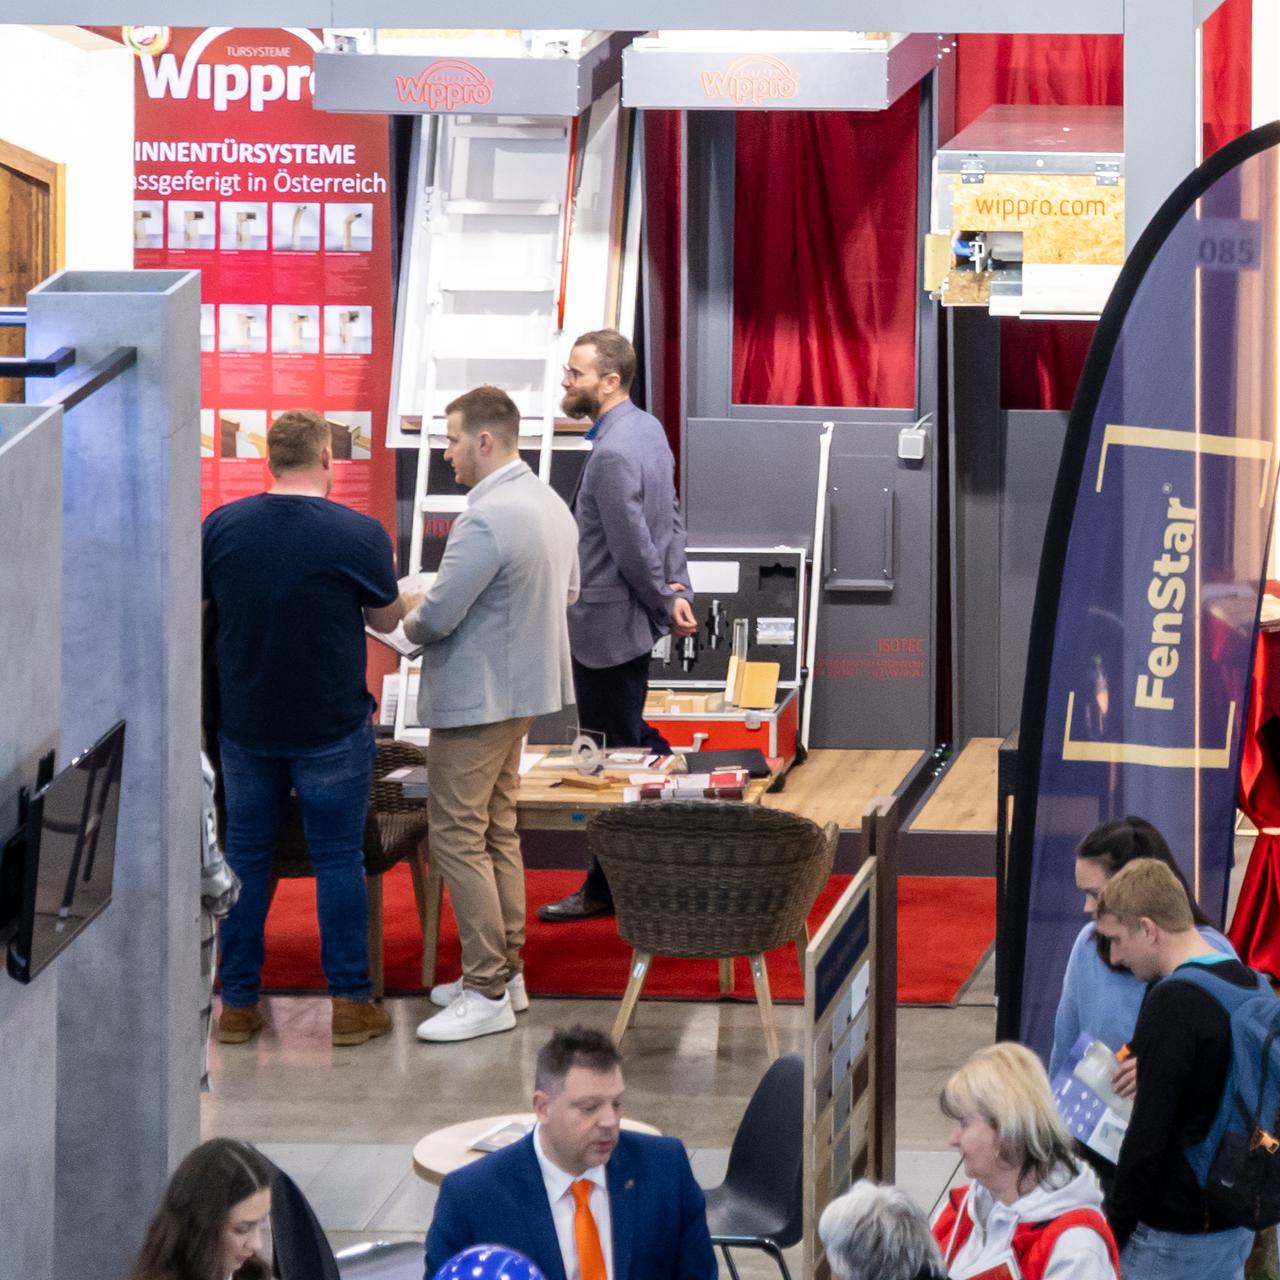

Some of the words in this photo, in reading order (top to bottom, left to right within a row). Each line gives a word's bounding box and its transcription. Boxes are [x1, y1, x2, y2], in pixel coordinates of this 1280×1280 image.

[227, 45, 291, 58] TÜRSYSTEME
[395, 64, 494, 111] Wippro
[702, 61, 800, 104] Wippro
[135, 139, 356, 165] INNENTÜRSYSTEME
[247, 171, 267, 192] in
[274, 169, 387, 193] Österreich
[975, 195, 1106, 220] wippro.com
[1200, 238, 1256, 264] 085
[1134, 497, 1198, 711] FenStar
